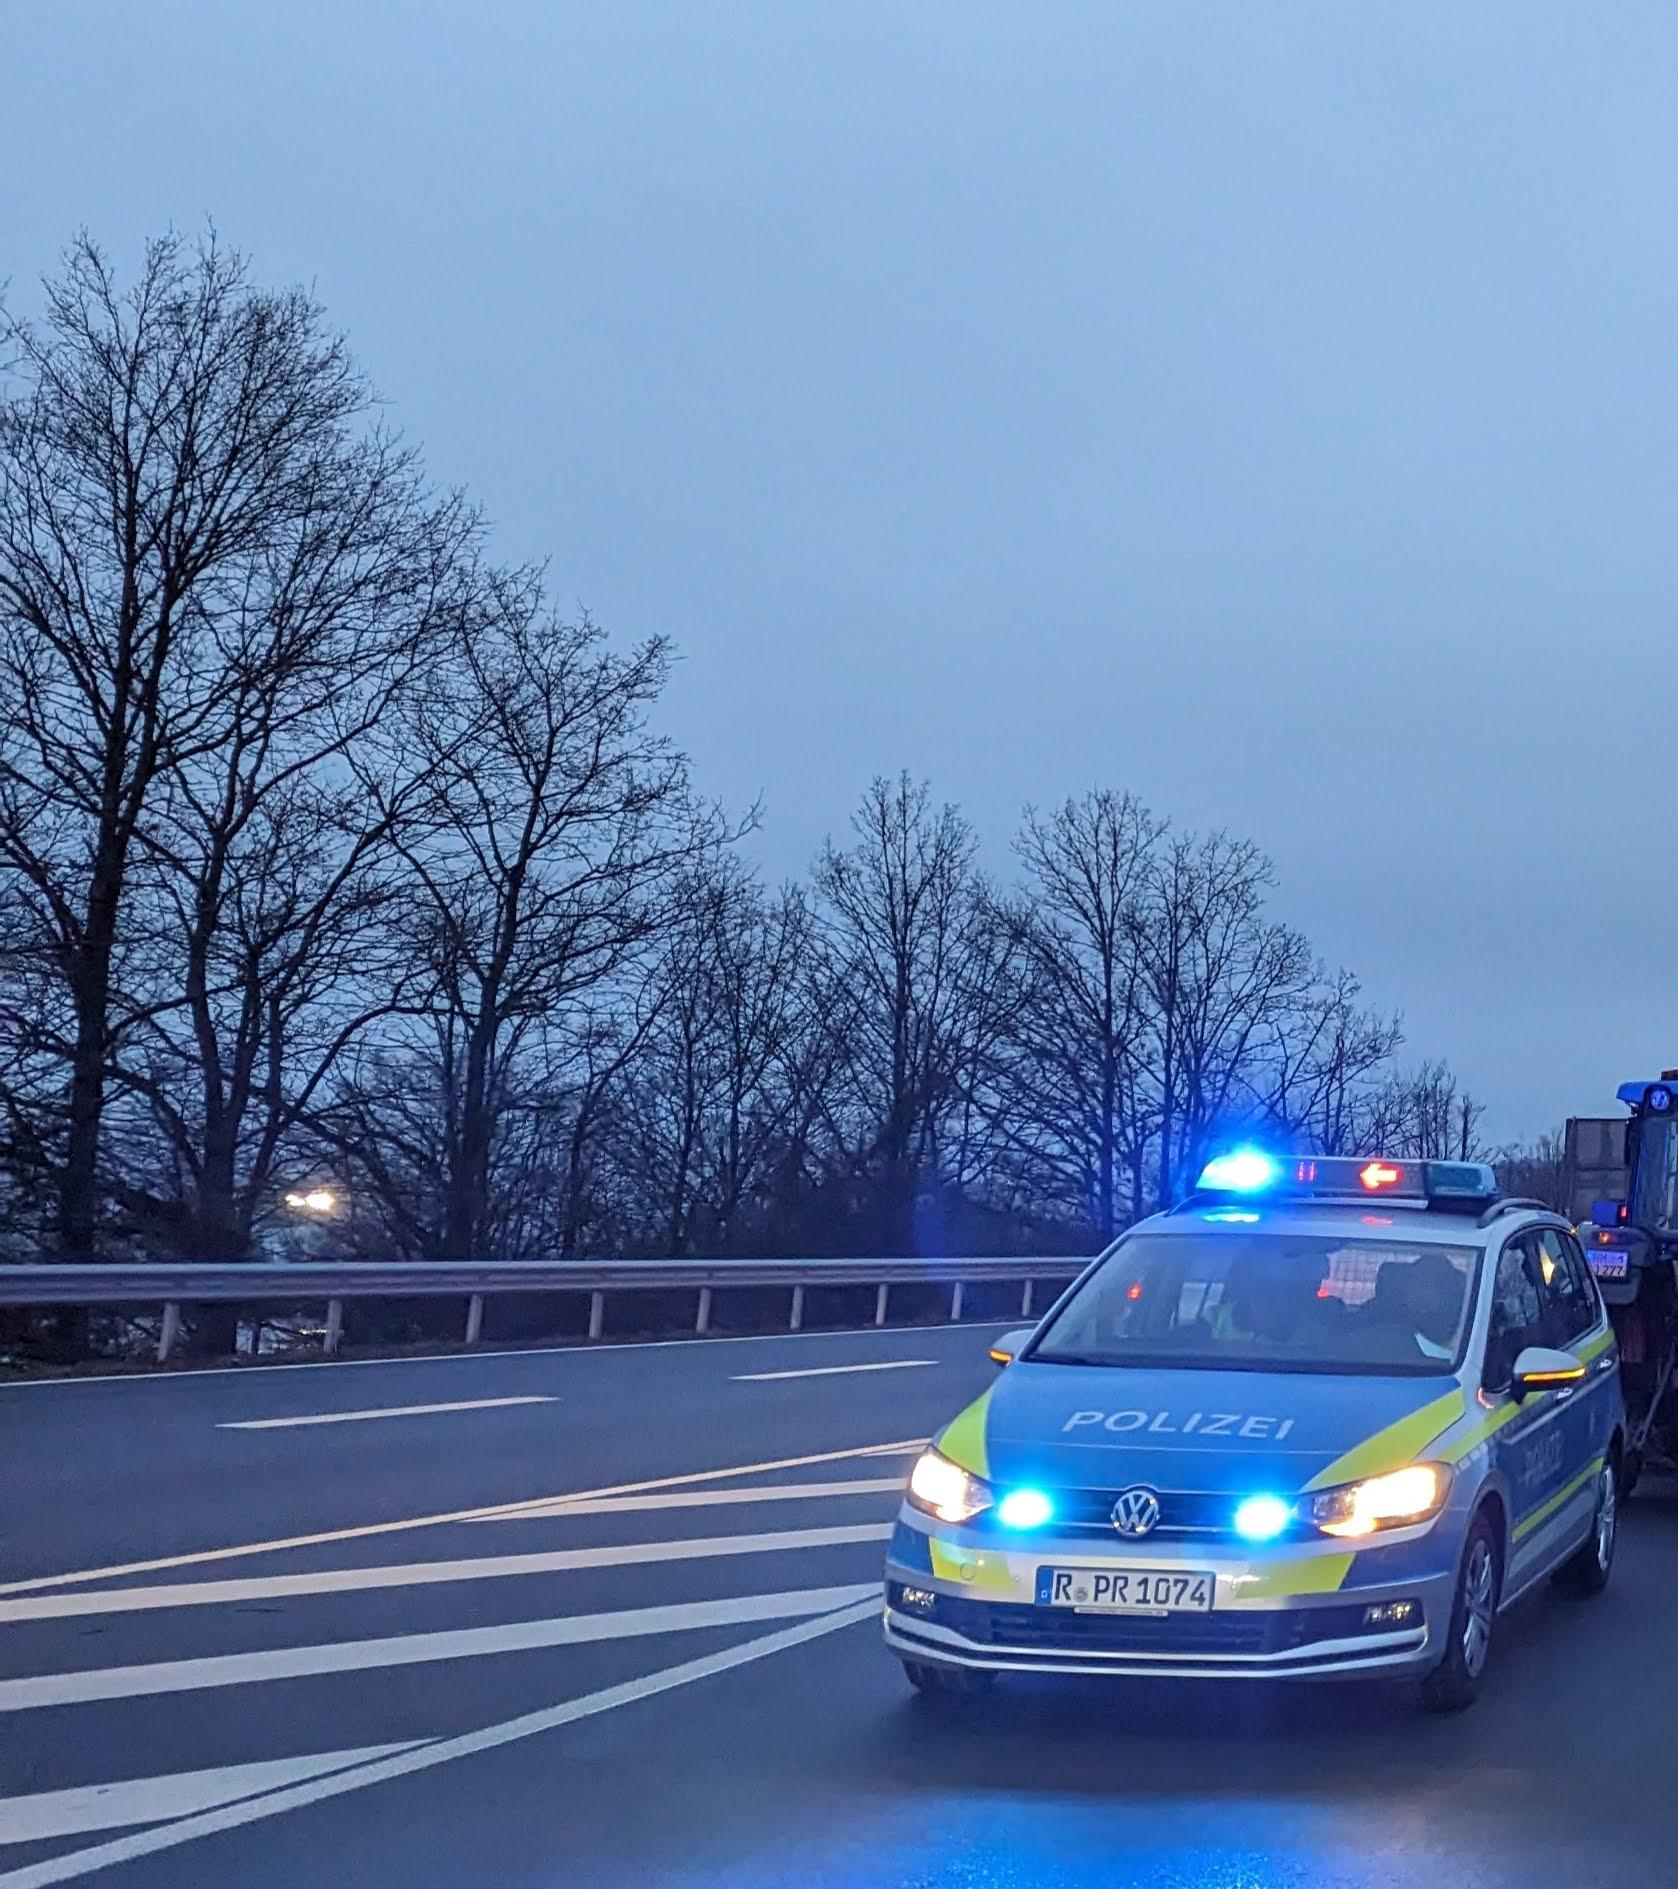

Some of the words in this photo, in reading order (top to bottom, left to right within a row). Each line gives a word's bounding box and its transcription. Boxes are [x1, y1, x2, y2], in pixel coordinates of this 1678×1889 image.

[1061, 1410, 1296, 1440] POLIZEI
[1054, 1572, 1073, 1601] R
[1093, 1574, 1129, 1604] PR
[1135, 1576, 1207, 1607] 1074
